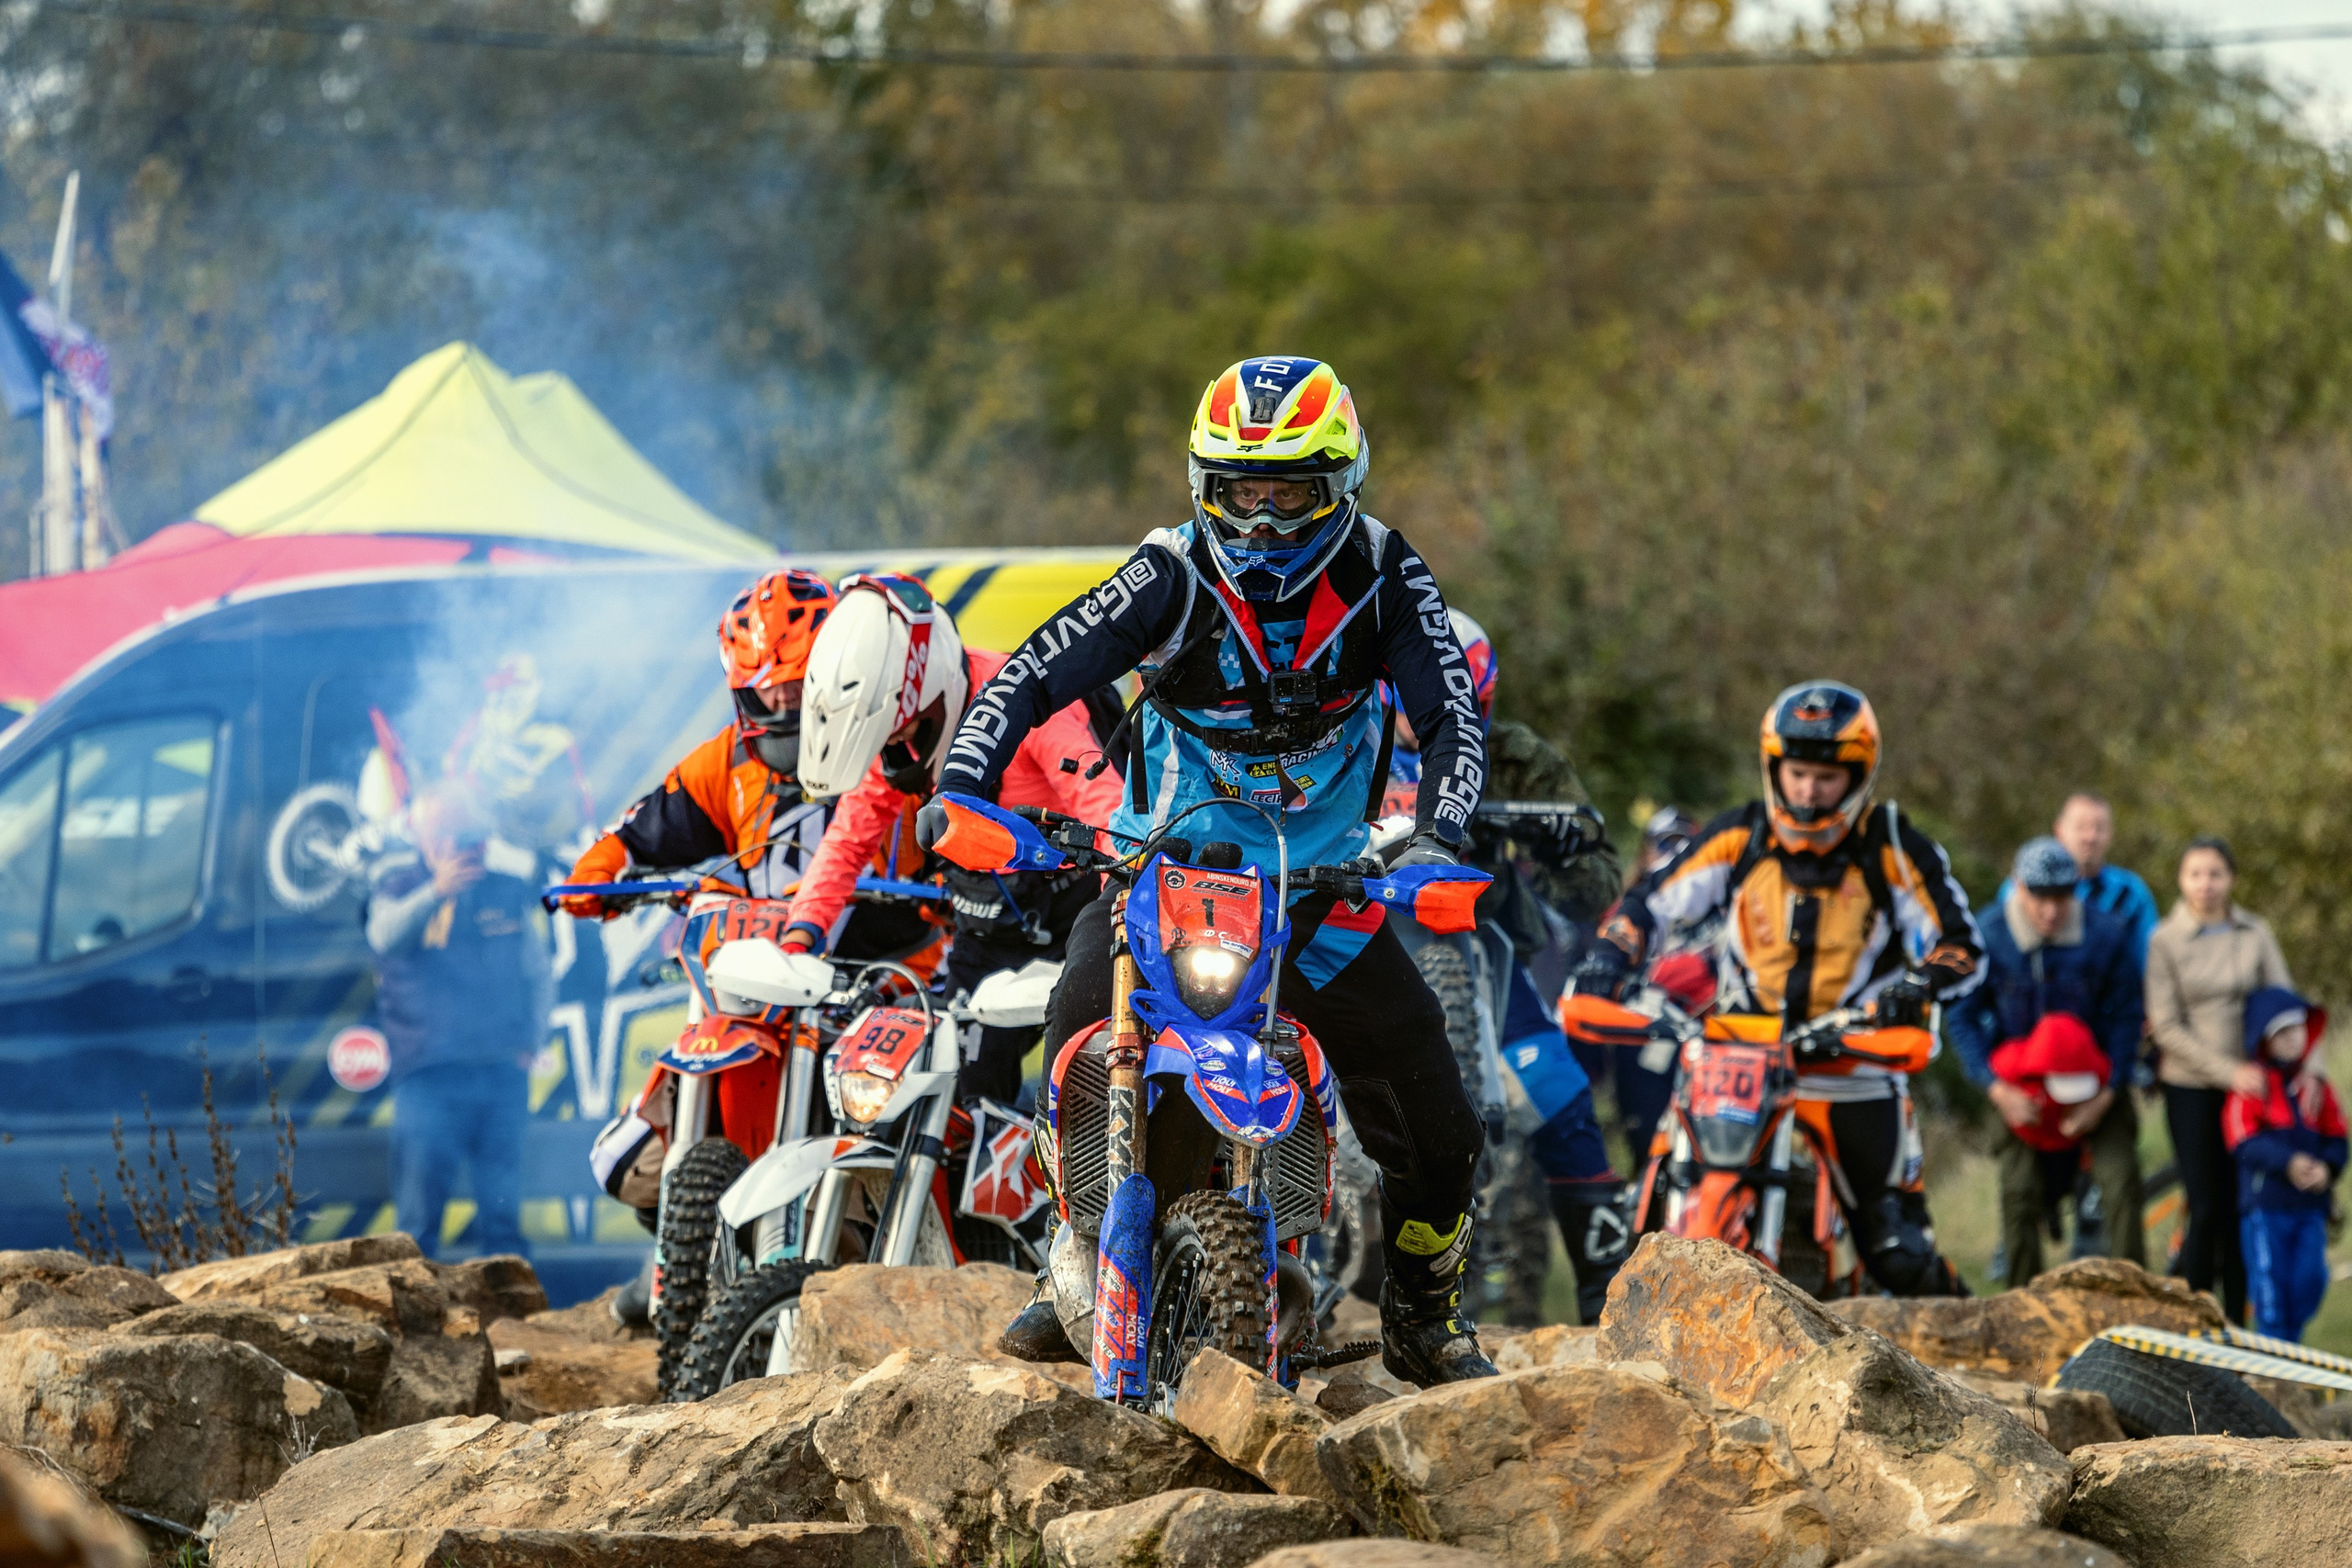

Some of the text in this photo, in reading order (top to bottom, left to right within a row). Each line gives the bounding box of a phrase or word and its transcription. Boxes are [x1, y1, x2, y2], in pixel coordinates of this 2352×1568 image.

[1201, 897, 1215, 928] 1
[858, 1026, 906, 1055] 98
[1206, 1082, 1234, 1094] MOLY
[1212, 1076, 1237, 1087] LIQUI
[1703, 1070, 1754, 1100] 120
[1126, 1314, 1137, 1348] MOLY
